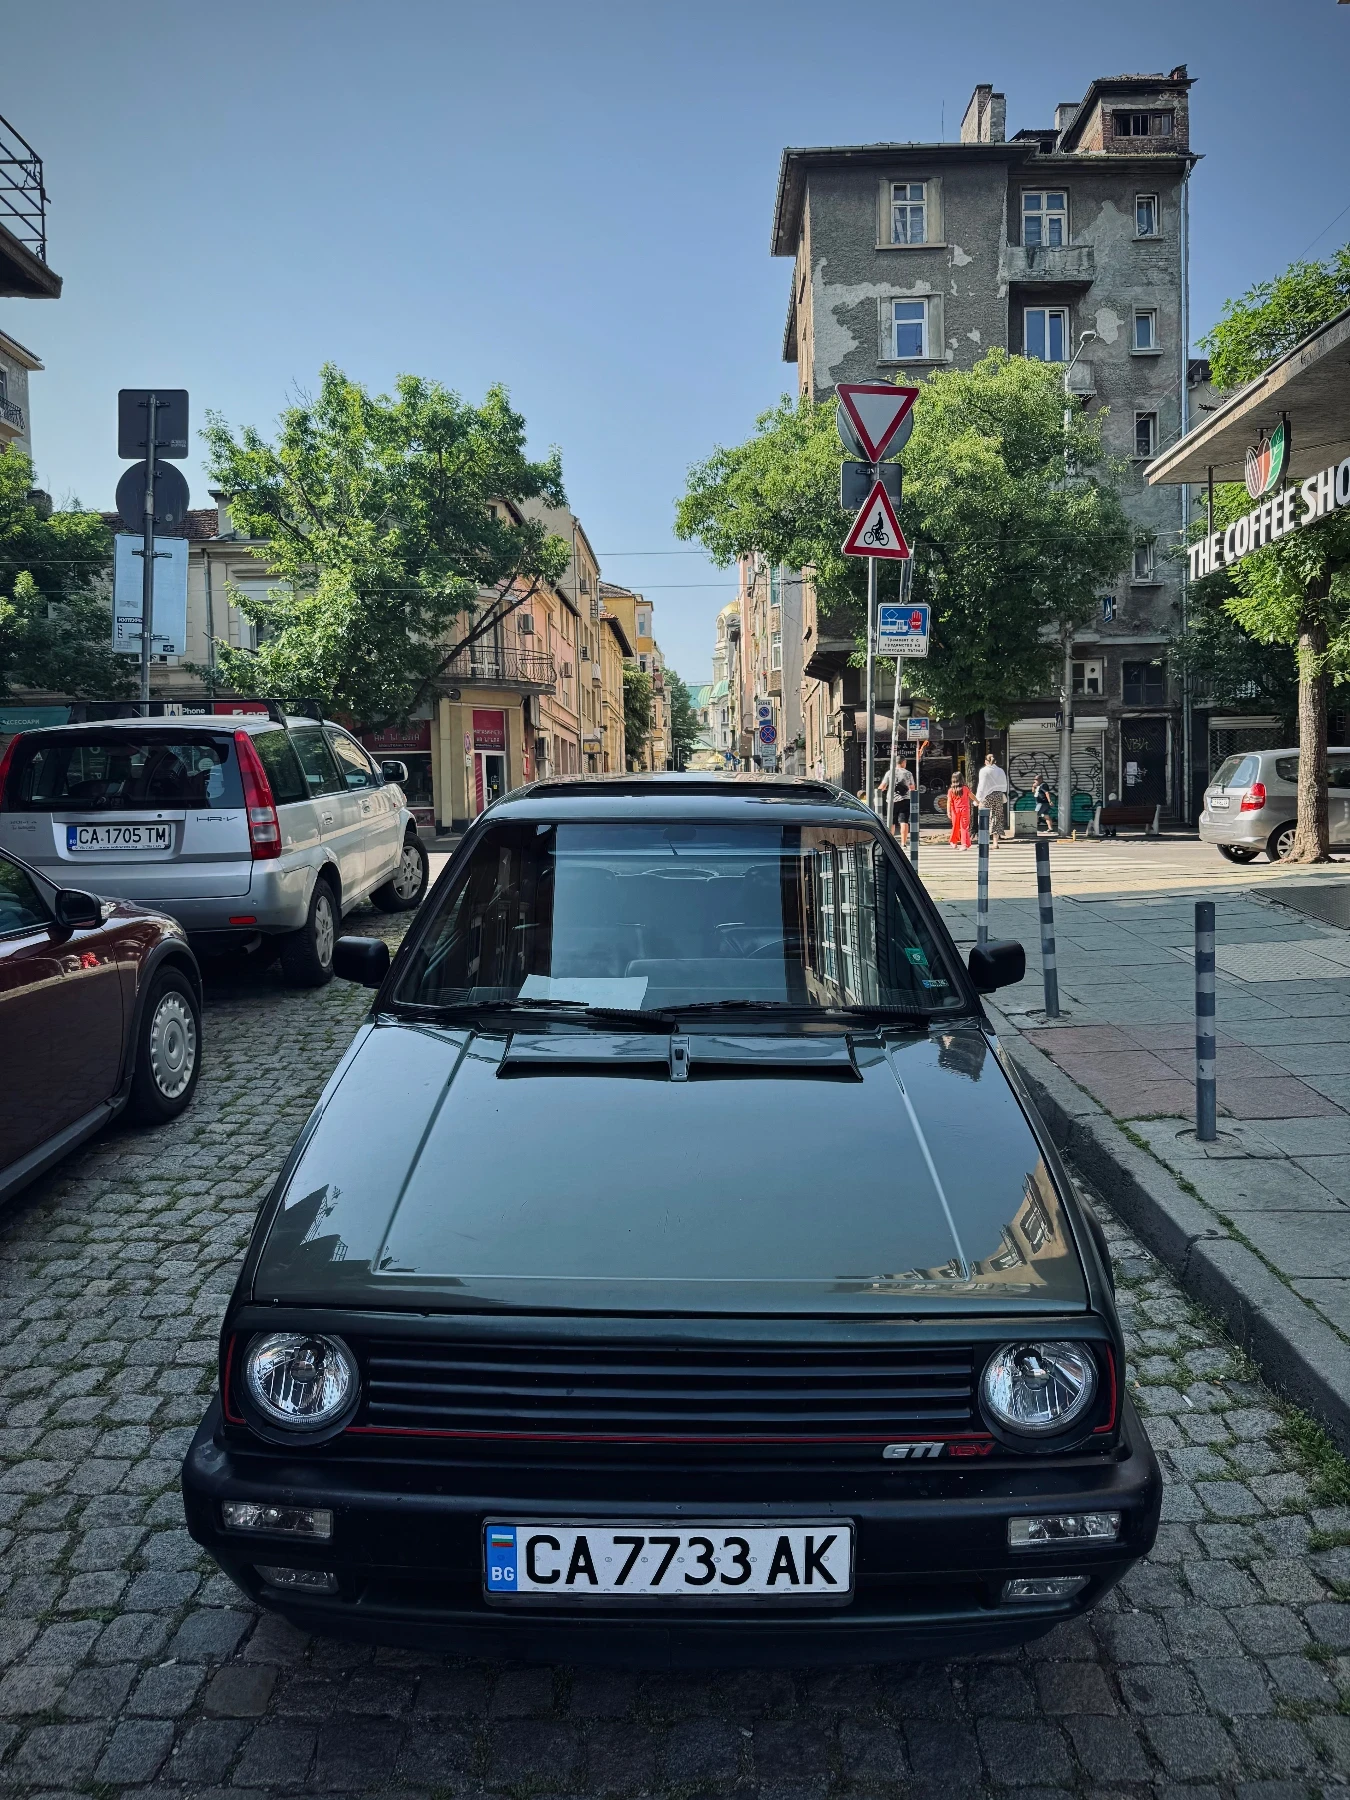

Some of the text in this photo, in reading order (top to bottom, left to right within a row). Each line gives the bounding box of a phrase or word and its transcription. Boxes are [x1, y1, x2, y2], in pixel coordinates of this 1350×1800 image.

[1187, 456, 1350, 582] THE COFFEE SHO
[79, 827, 166, 844] CA 1705 TM
[882, 1442, 996, 1459] GTI 16V
[525, 1534, 839, 1587] CA 7733 AK
[491, 1566, 515, 1581] BG
